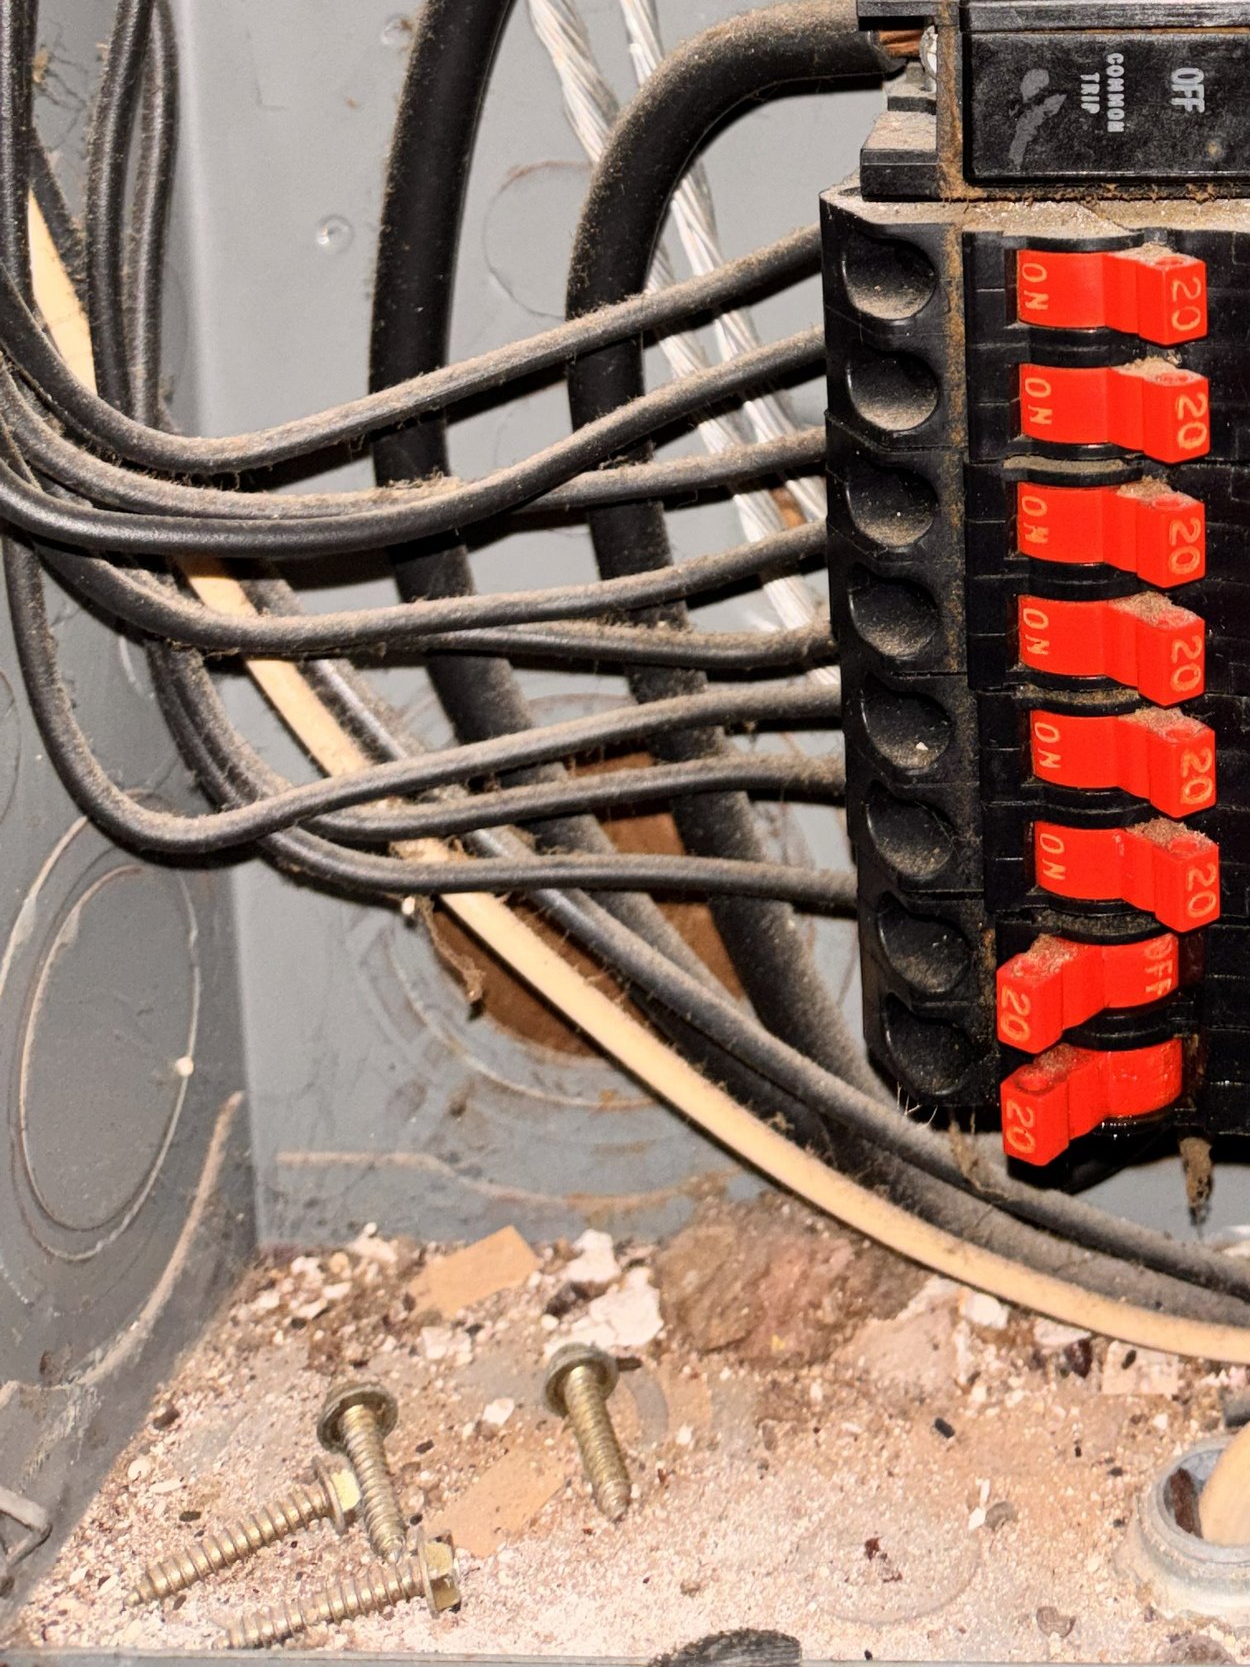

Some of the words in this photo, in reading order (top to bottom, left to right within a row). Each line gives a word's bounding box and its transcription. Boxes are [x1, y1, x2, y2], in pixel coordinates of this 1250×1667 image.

[1080, 72, 1100, 114] TRIP
[1106, 53, 1124, 132] COMMON
[1170, 67, 1205, 113] OFF
[1022, 262, 1049, 311] ON
[1171, 277, 1201, 332] 20
[1024, 376, 1054, 425] ON
[1176, 392, 1207, 449] 20
[1022, 494, 1049, 544] ON
[1169, 517, 1201, 575] 20
[1023, 607, 1051, 656] ON
[1170, 635, 1203, 693] 20
[1035, 722, 1061, 769] ON
[1180, 749, 1213, 805] 20
[1040, 833, 1066, 880] ON
[1187, 862, 1217, 918] 20
[1144, 940, 1173, 998] OFF
[1001, 985, 1031, 1042] 20
[1005, 1099, 1036, 1154] 20
